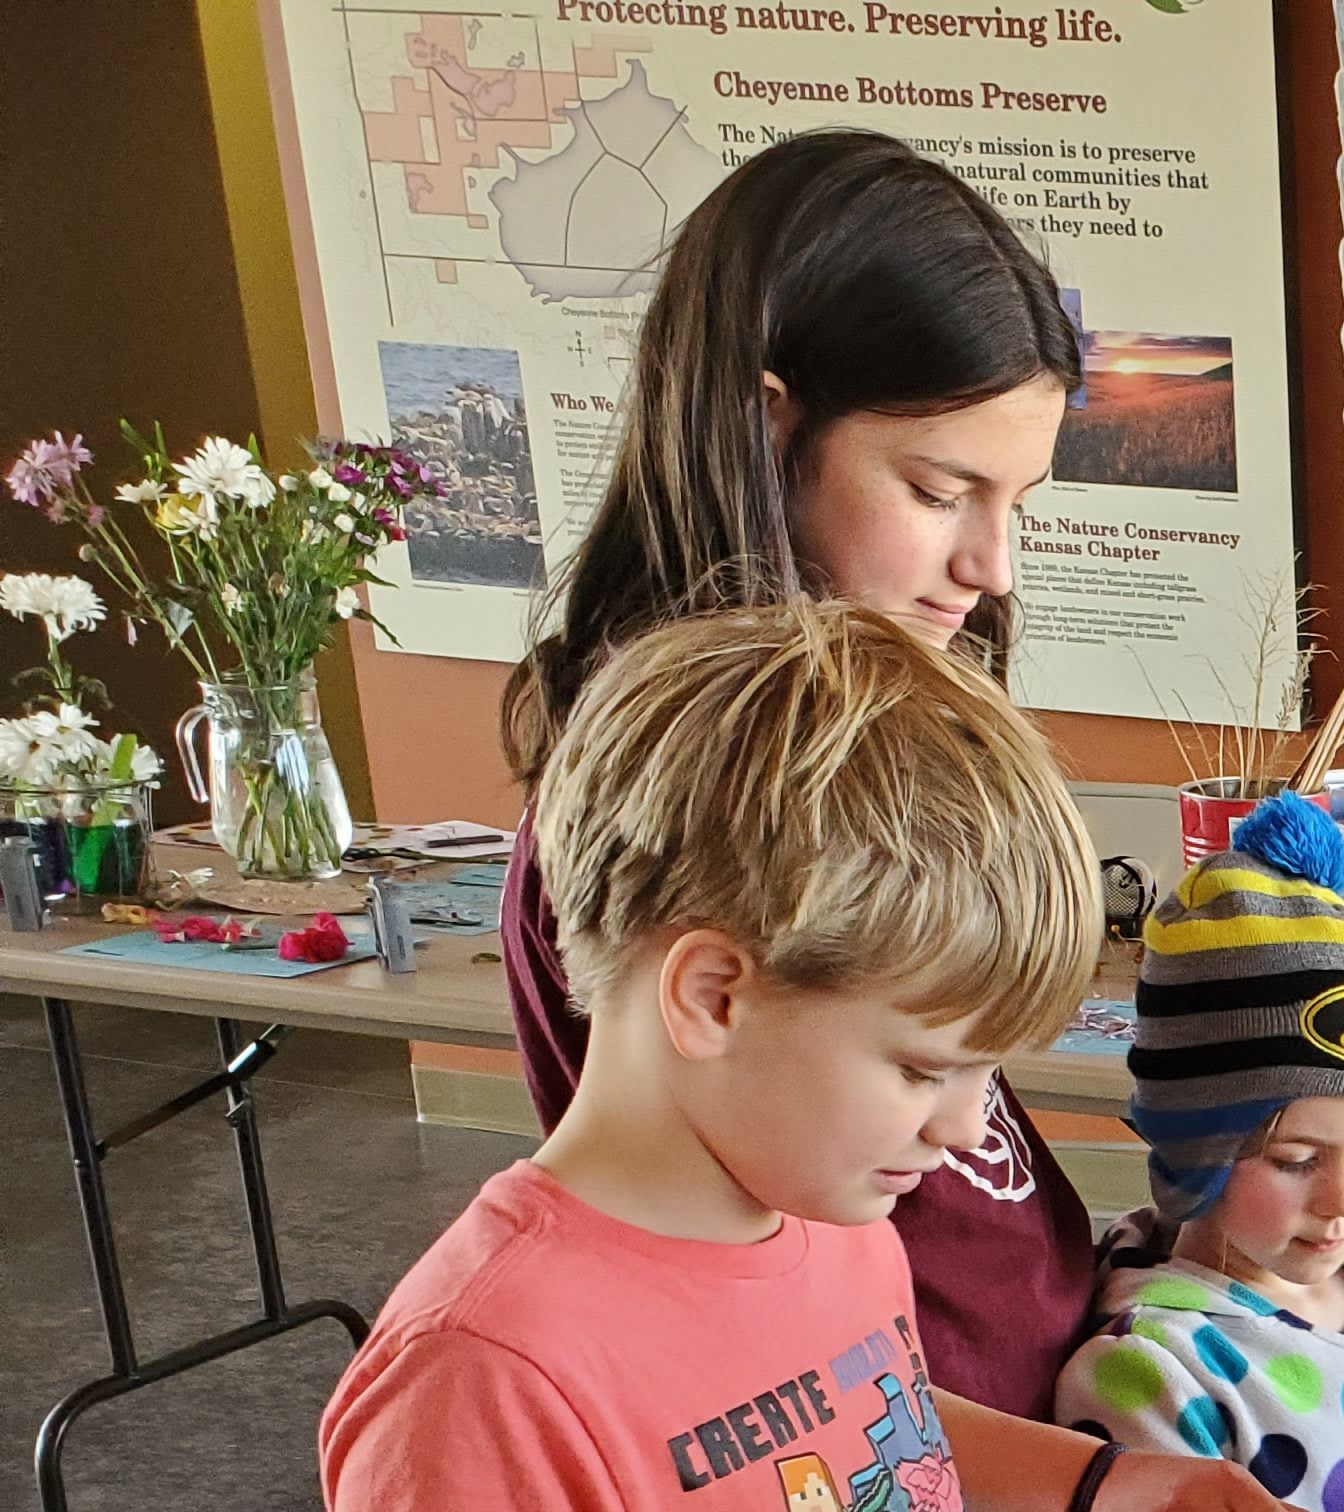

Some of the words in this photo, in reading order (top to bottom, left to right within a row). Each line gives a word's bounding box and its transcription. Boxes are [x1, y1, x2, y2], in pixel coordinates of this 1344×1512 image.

[557, 0, 728, 35] Protecting
[735, 1, 855, 33] nature.
[863, 2, 1048, 47] Preserving
[1055, 9, 1122, 43] life.
[713, 71, 849, 105] Cheyenne
[856, 77, 973, 108] Bottoms
[980, 83, 1107, 113] Preserve
[718, 123, 755, 143] The
[978, 136, 1053, 158] mission
[1060, 139, 1076, 159] is
[1082, 141, 1102, 159] to
[1108, 145, 1195, 165] preserve
[953, 163, 1026, 183] natural
[1032, 166, 1161, 188] communities
[1167, 170, 1208, 190] that
[1014, 192, 1039, 207] on
[1043, 189, 1100, 210] Earth
[1107, 192, 1131, 215] by
[1040, 215, 1083, 238] they
[1090, 218, 1137, 237] need
[1142, 220, 1163, 238] to
[550, 392, 587, 411] Who
[590, 395, 615, 413] We
[1019, 515, 1051, 532] The
[1057, 517, 1118, 537] Nature
[1125, 523, 1240, 549] Conservancy
[1019, 536, 1082, 555] Kansas
[1088, 541, 1160, 562] Chapter
[668, 1370, 835, 1493] CREATE
